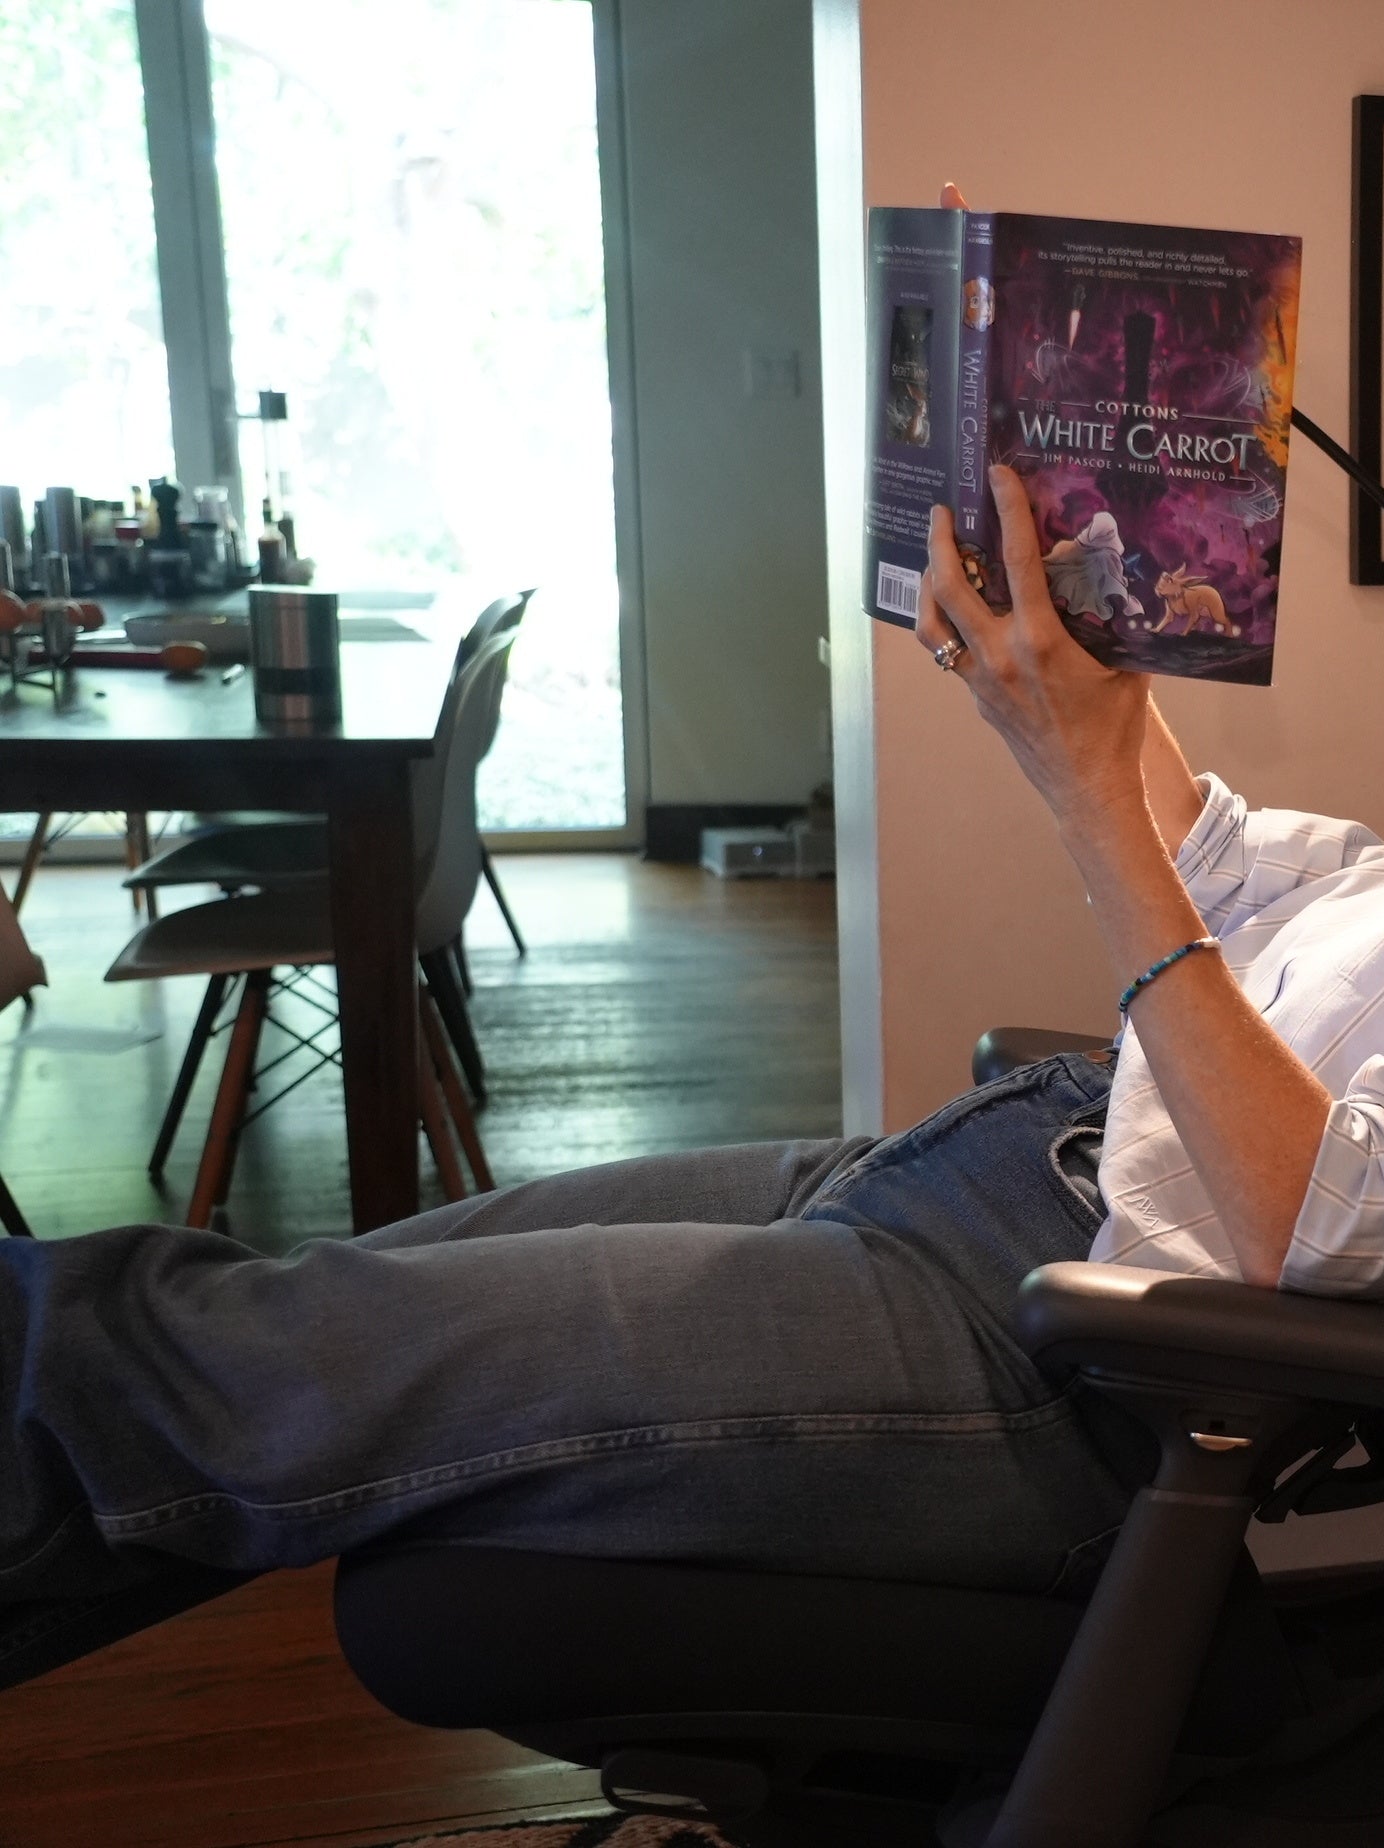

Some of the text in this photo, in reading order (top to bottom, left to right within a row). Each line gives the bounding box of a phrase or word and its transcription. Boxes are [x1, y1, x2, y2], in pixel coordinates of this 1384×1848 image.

[1050, 252, 1234, 275] storytelling the reader and never lets
[959, 350, 981, 493] WHITE CARROT
[1095, 401, 1179, 421] COTTONS
[1018, 410, 1257, 471] WHITE CARROT
[1043, 452, 1226, 482] JIM PASCOE HEIDI ARNHOLD
